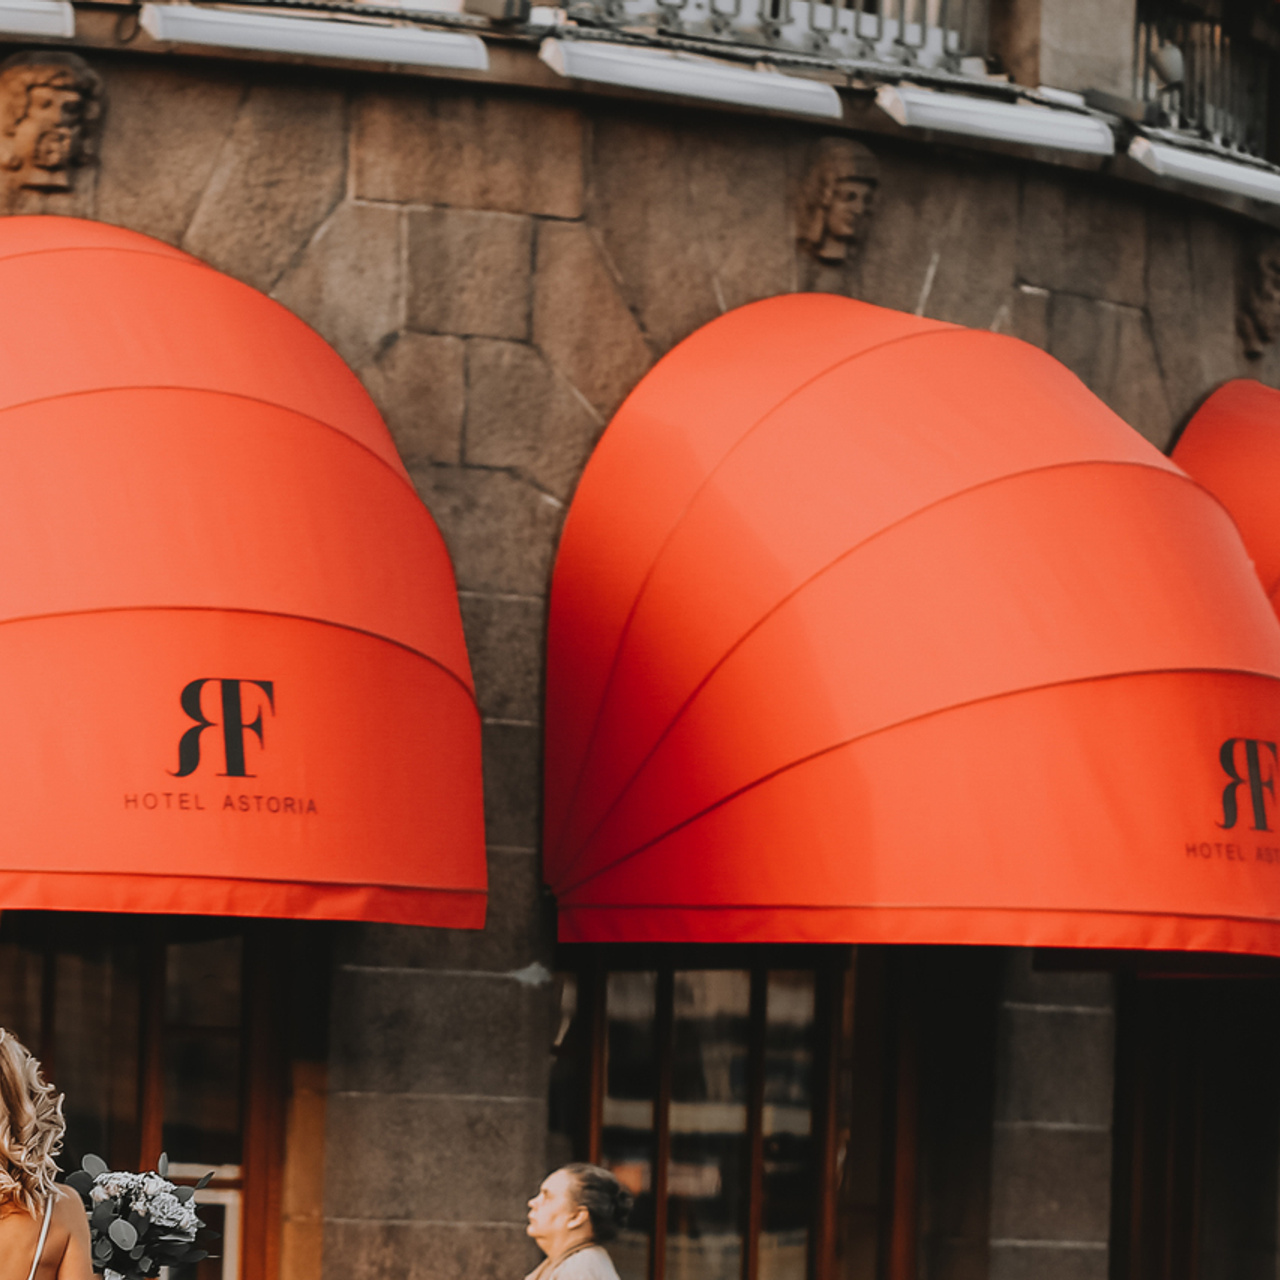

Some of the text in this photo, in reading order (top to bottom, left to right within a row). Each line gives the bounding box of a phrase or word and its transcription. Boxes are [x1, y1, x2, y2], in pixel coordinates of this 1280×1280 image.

[124, 792, 318, 815] HOTEL ASTORIA
[1185, 842, 1245, 862] HOTEL
